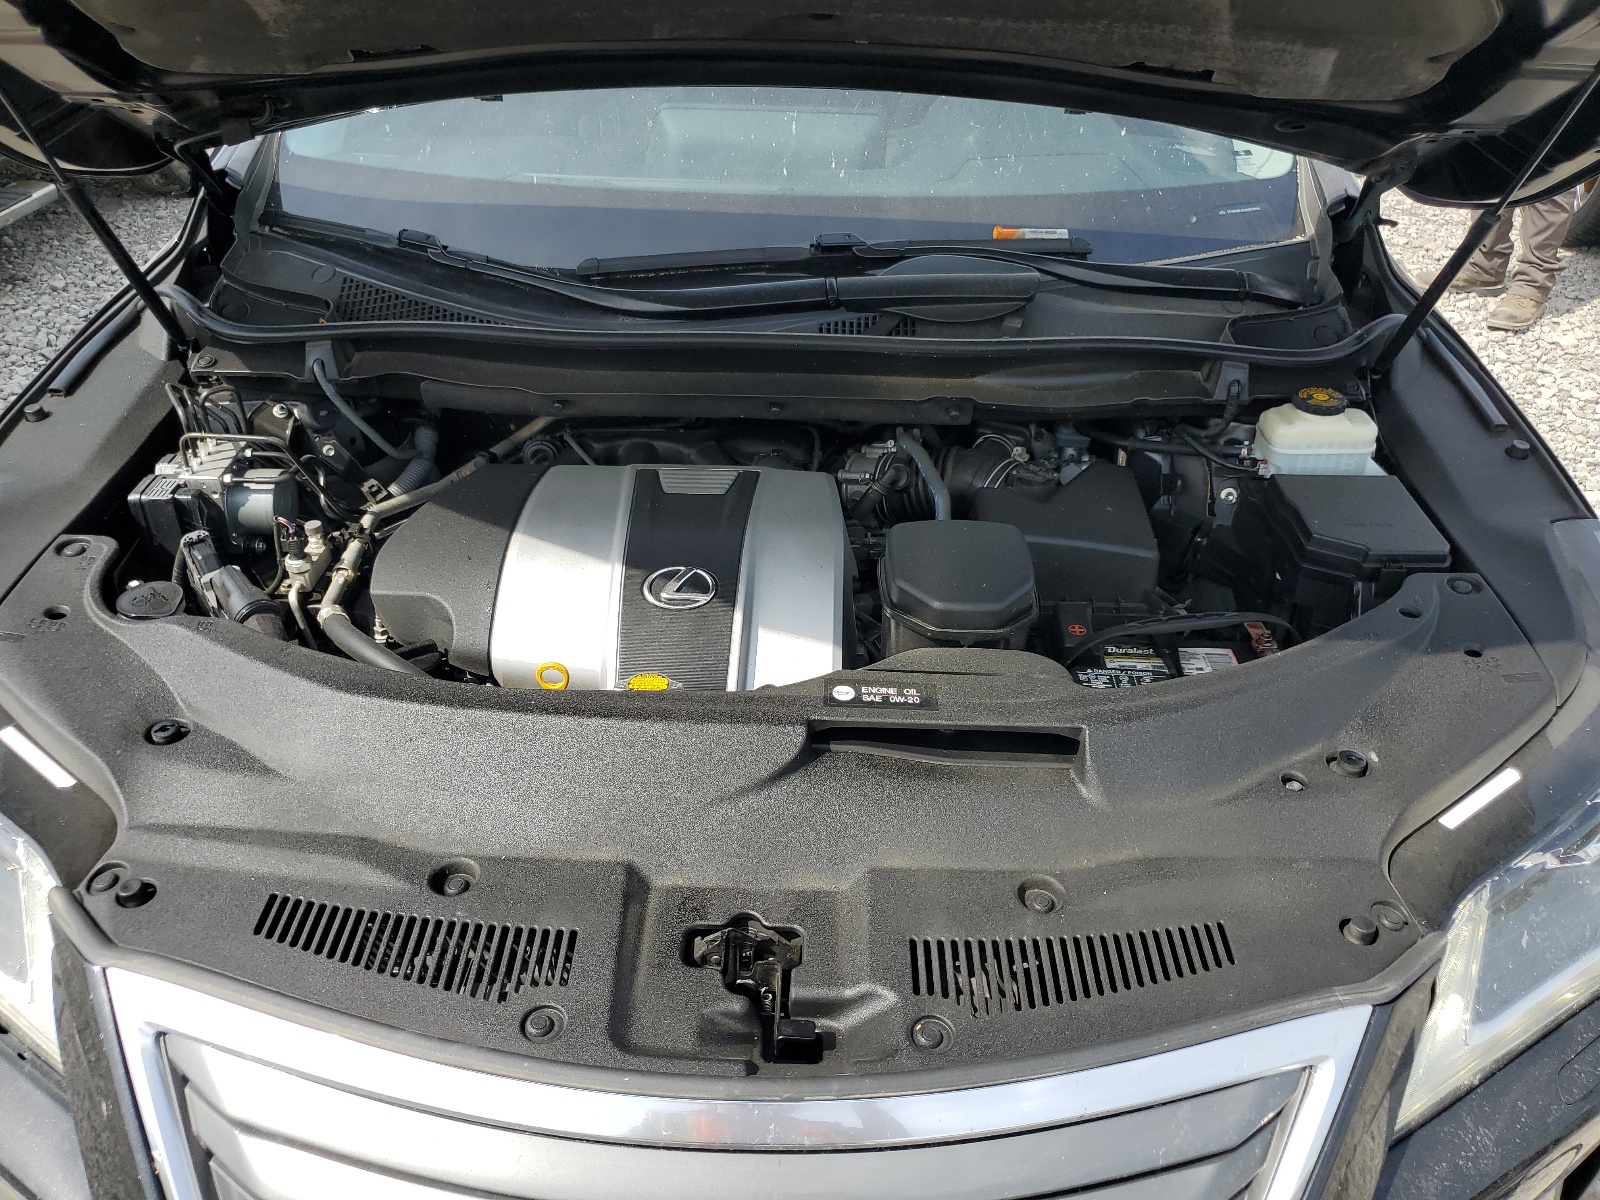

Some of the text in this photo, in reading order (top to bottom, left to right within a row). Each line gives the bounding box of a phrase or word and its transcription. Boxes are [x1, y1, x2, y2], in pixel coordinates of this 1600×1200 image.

[1104, 646, 1155, 655] Duralast
[861, 686, 898, 695] ENGINE
[862, 694, 920, 703] SAE 0W-20
